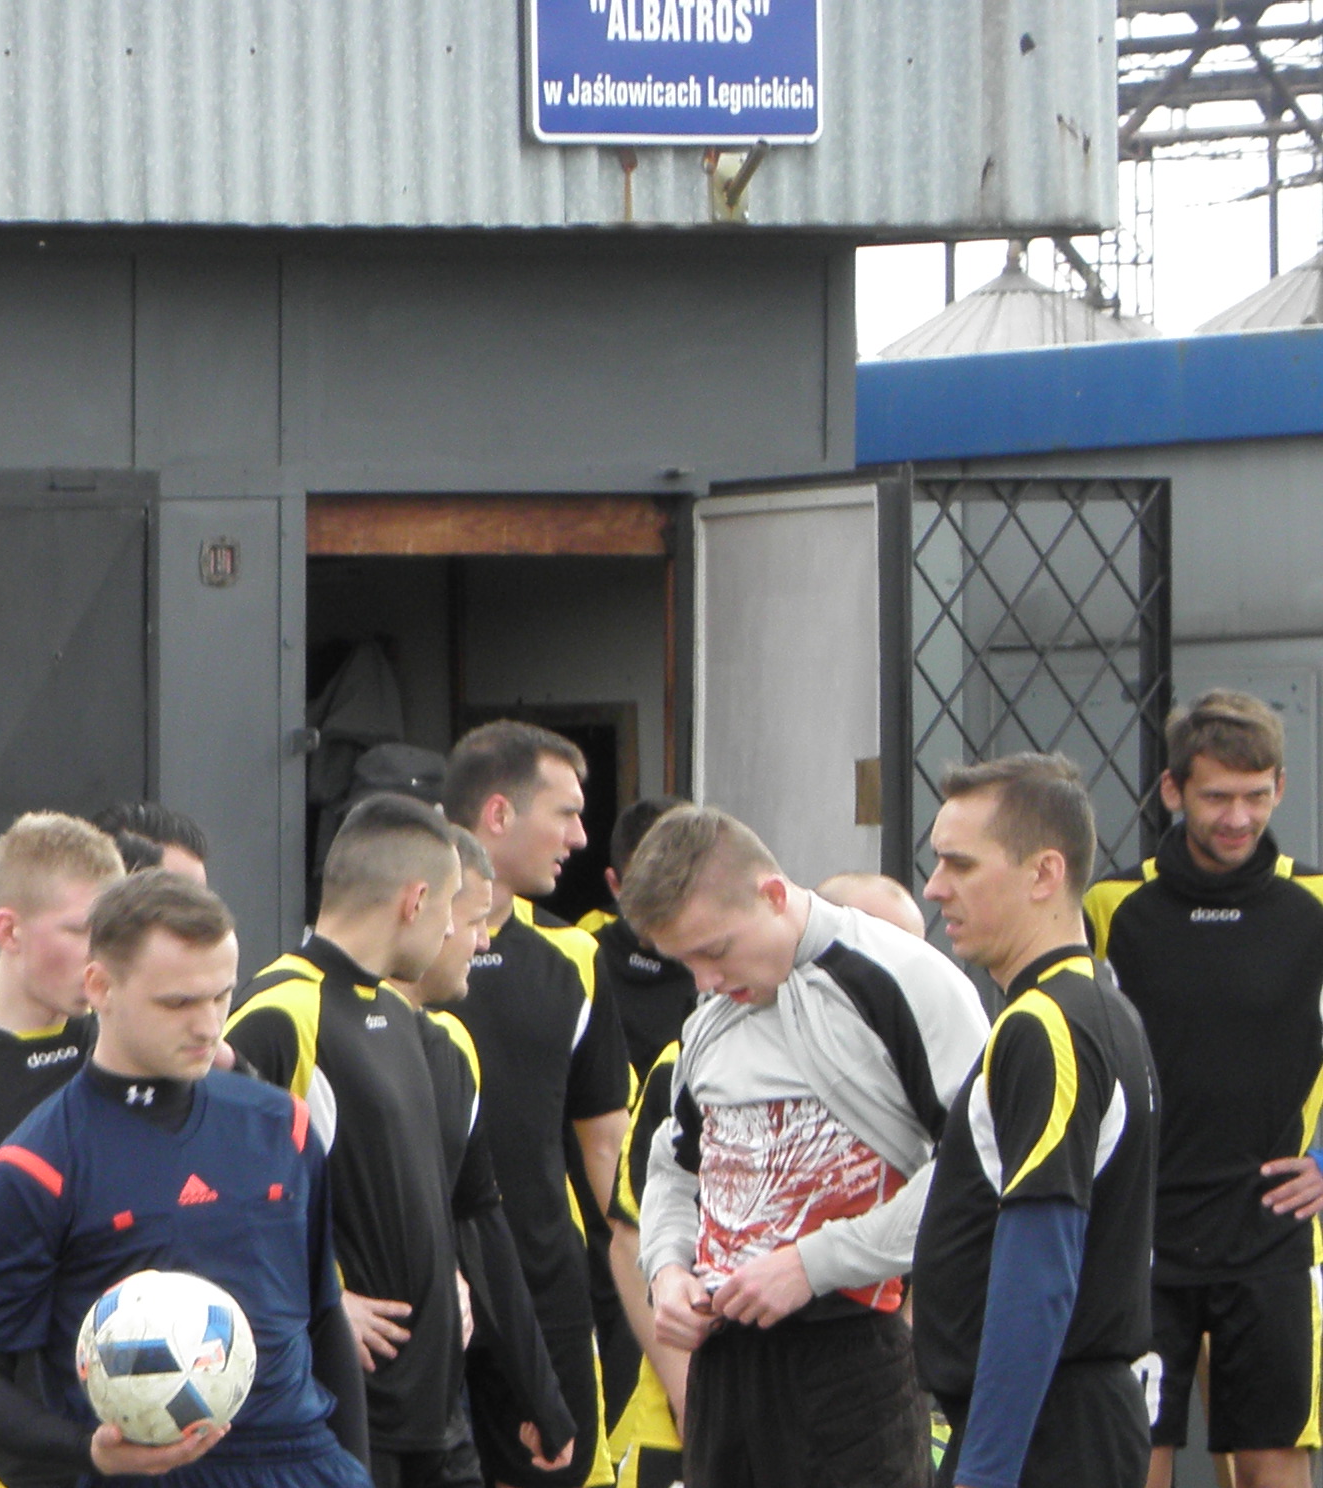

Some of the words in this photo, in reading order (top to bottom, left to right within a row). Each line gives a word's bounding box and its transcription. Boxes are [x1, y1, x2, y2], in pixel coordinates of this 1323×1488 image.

[543, 80, 563, 106] w
[567, 73, 701, 108] Jaśkowicach
[708, 75, 814, 115] Legnickich
